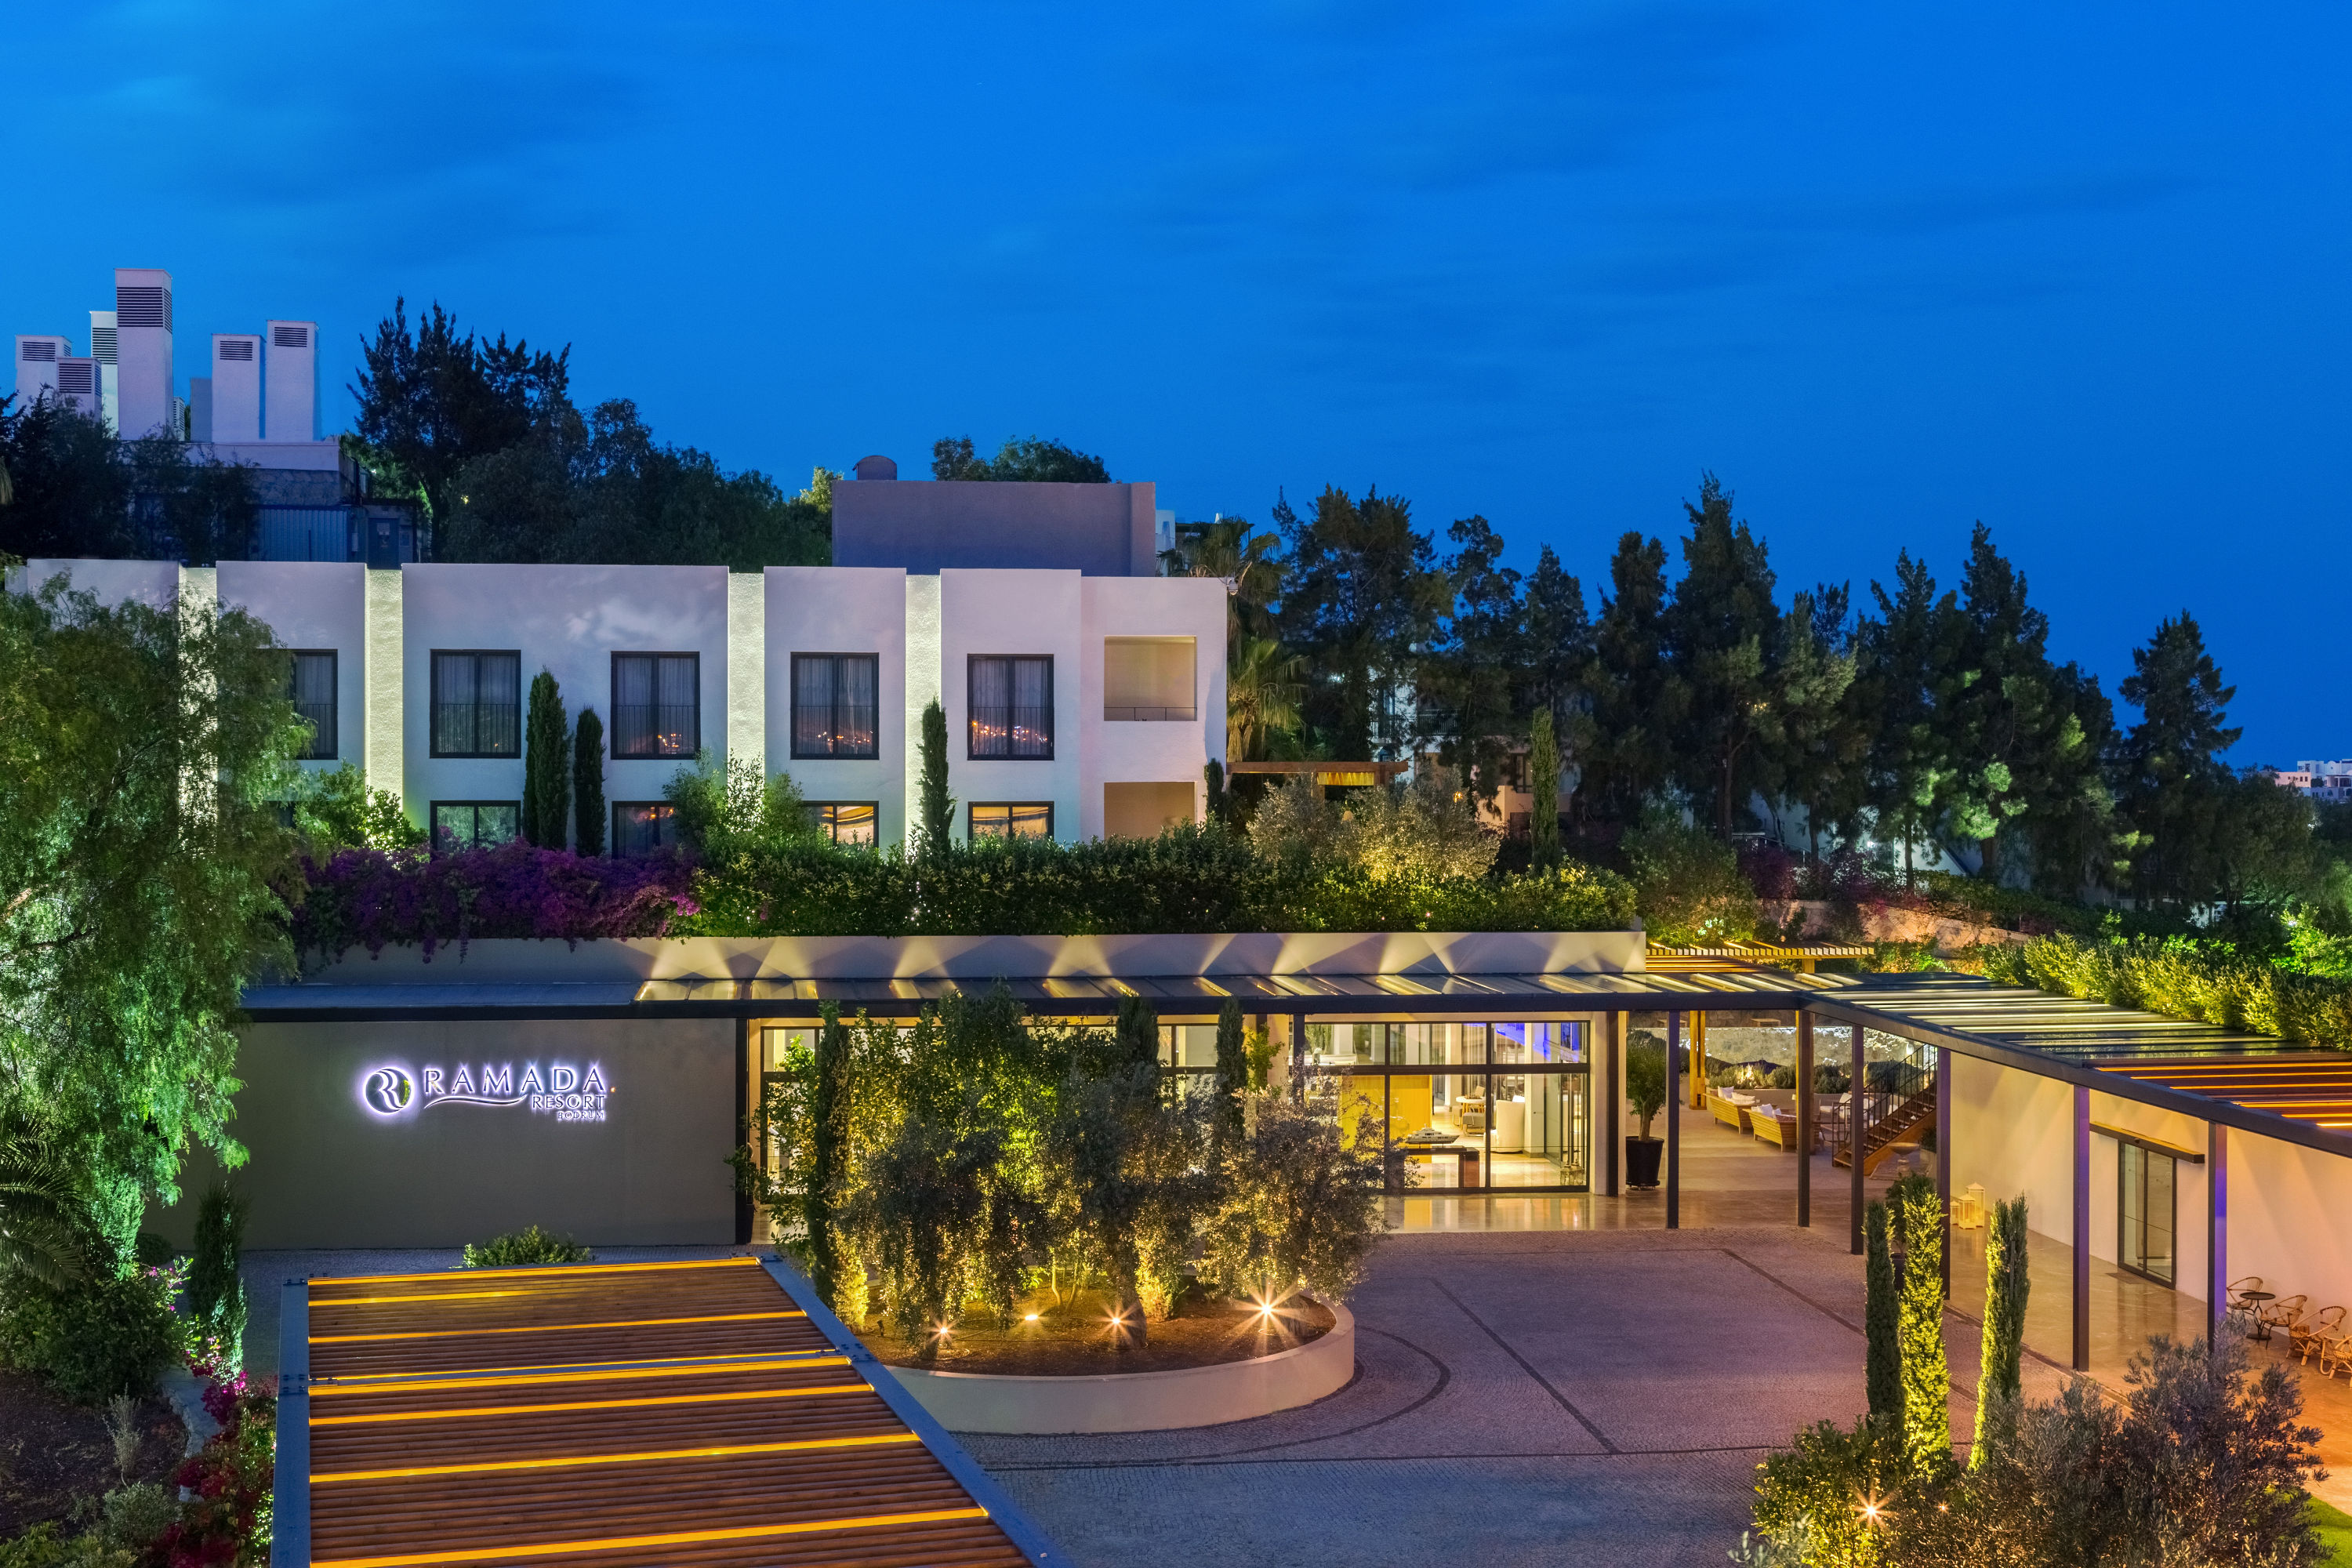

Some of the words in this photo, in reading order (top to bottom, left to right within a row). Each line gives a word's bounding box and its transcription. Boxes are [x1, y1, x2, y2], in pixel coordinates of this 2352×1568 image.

[423, 1066, 606, 1094] RAMADA
[532, 1094, 606, 1109] RESORT
[557, 1111, 604, 1120] BODRUM
